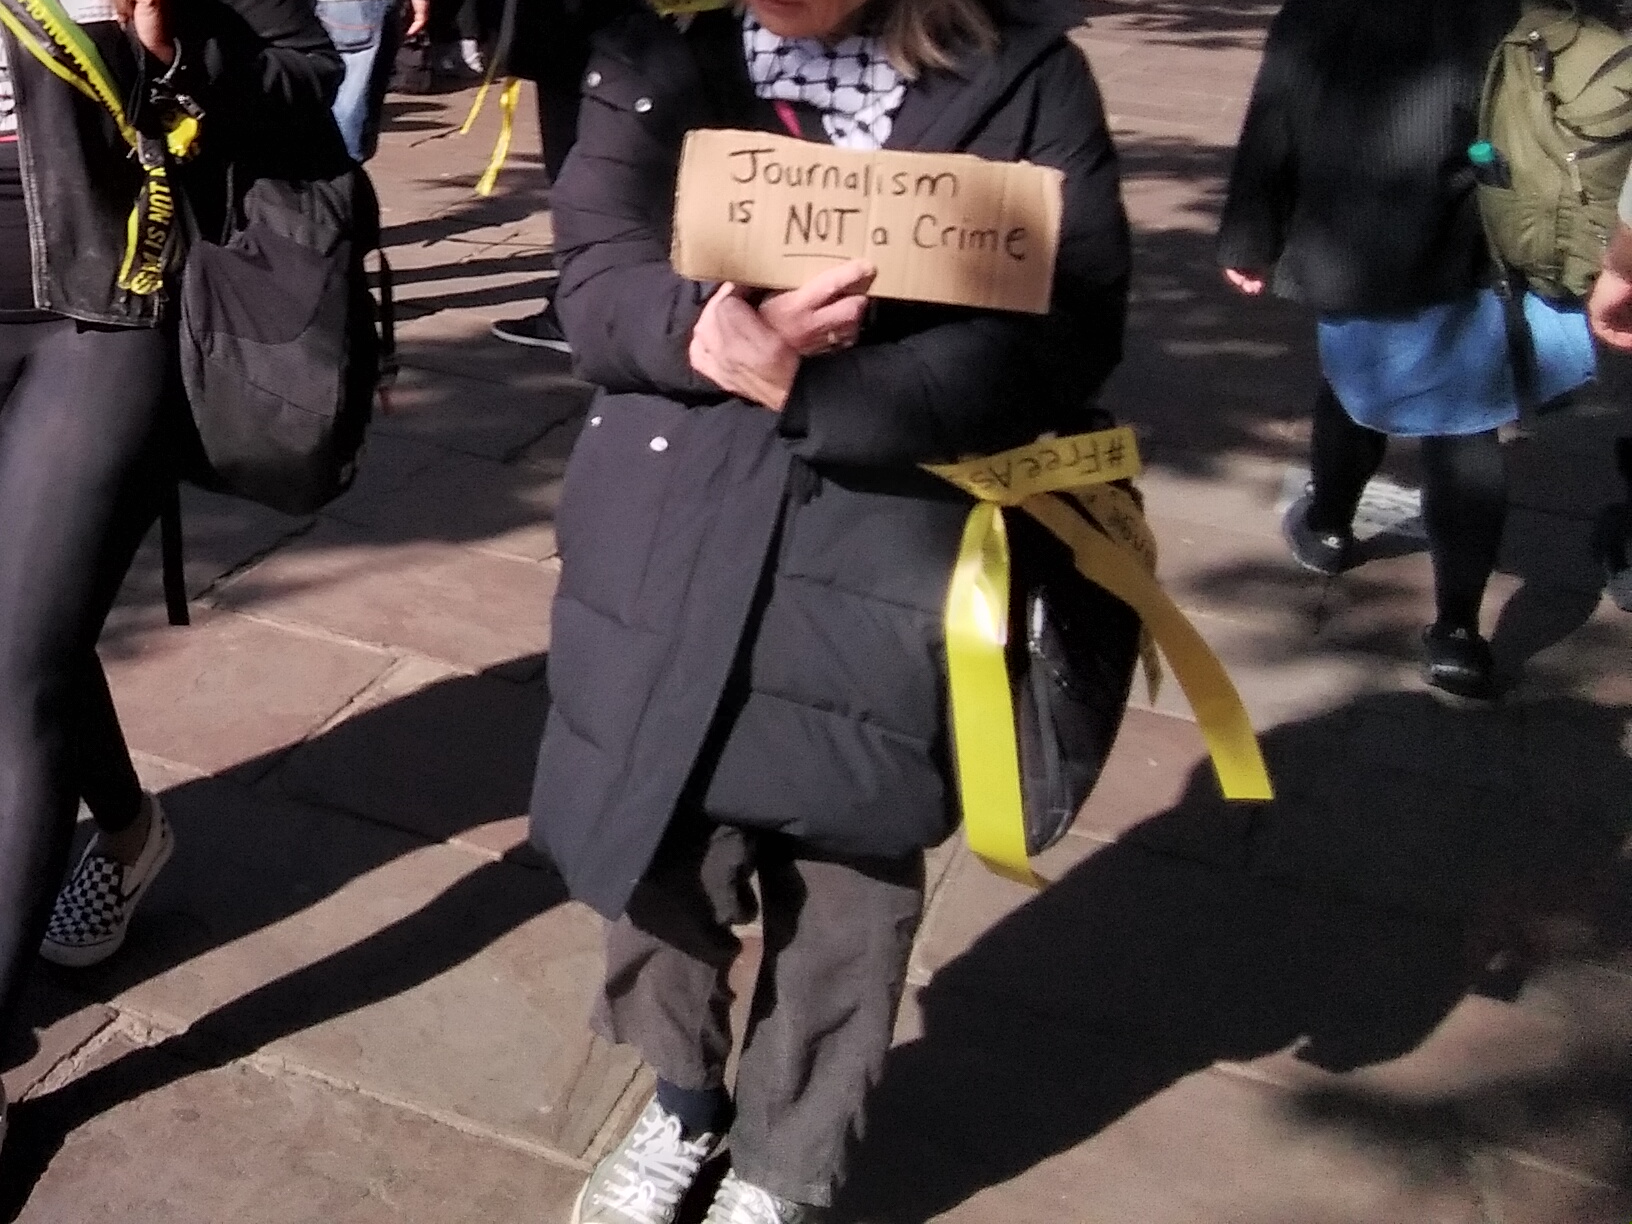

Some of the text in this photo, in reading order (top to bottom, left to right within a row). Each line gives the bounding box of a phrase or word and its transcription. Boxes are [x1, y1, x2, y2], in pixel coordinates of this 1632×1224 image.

[727, 147, 961, 197] Journalism
[783, 202, 861, 247] NOT
[871, 226, 889, 245] a
[912, 213, 1027, 261] Crime
